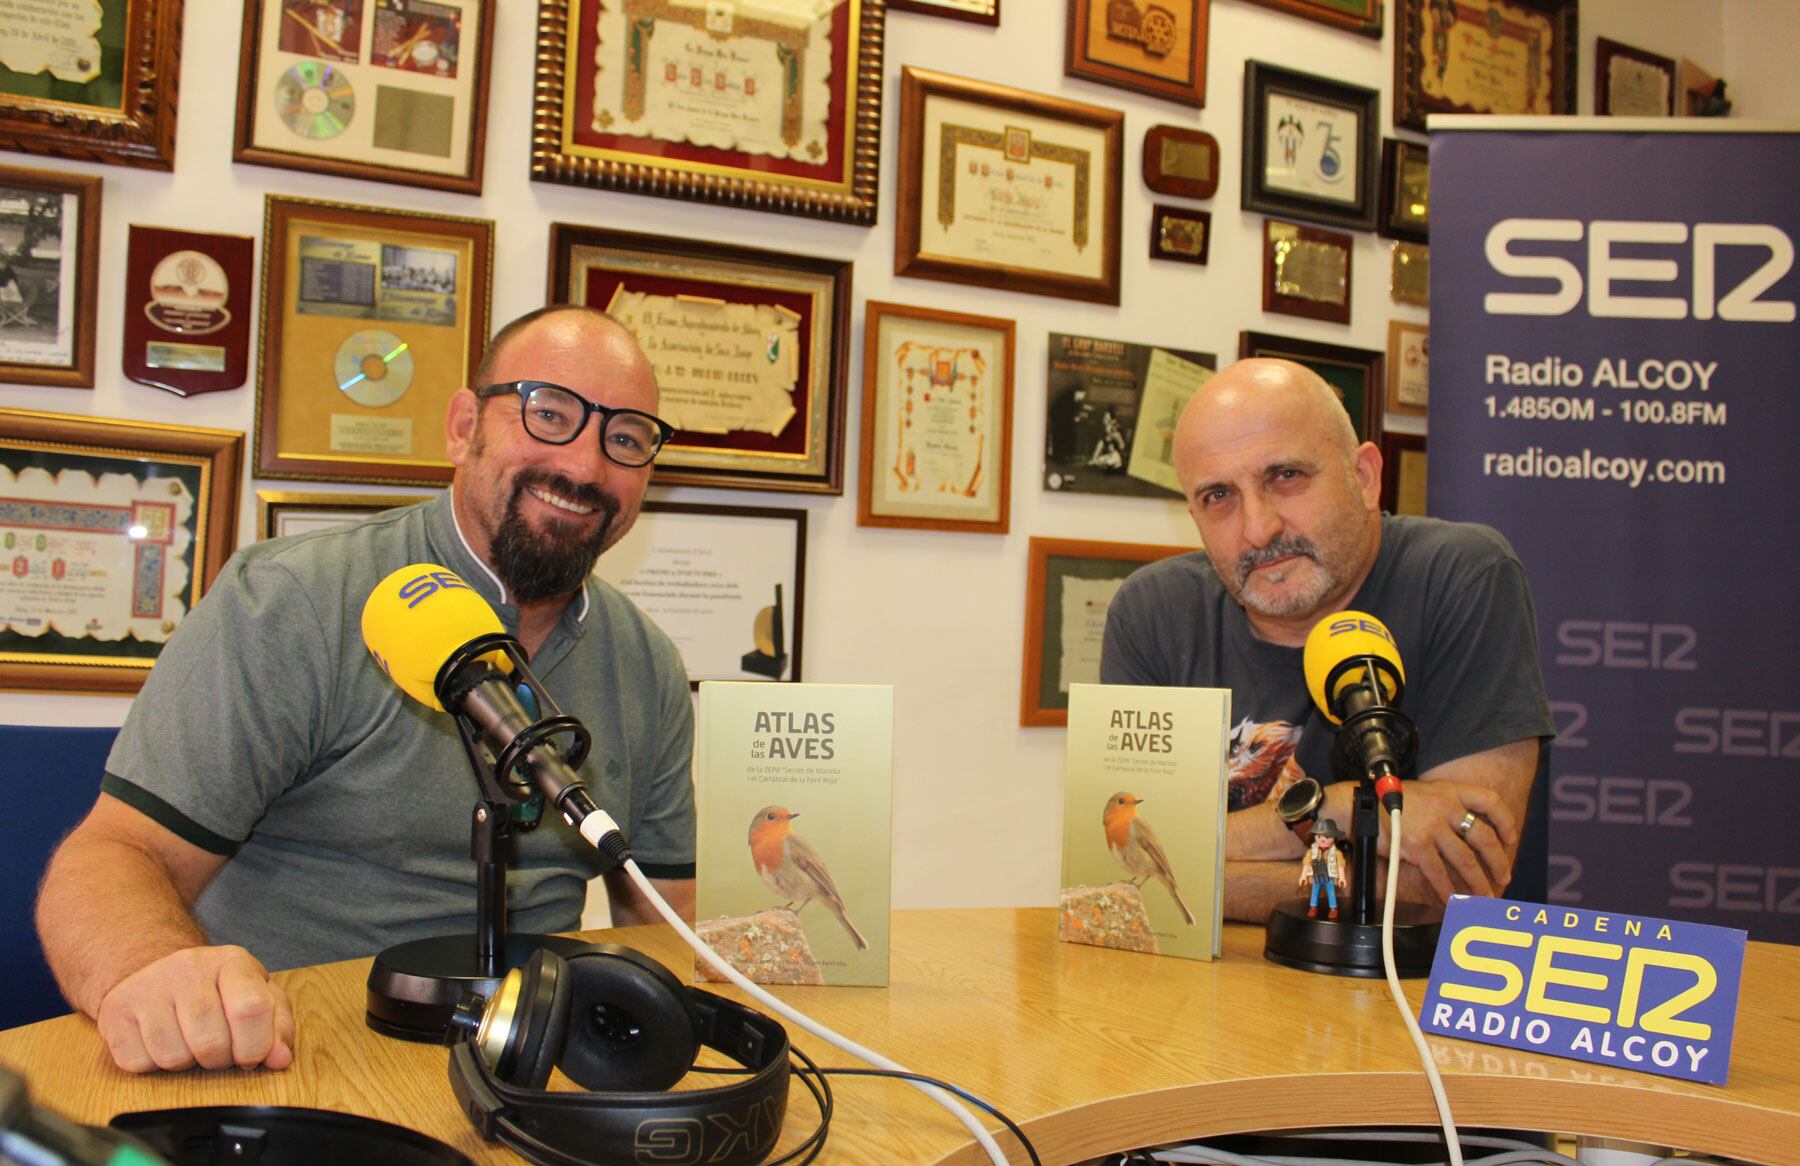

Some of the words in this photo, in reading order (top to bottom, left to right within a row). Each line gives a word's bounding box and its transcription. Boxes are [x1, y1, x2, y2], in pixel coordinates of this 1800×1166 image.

[1484, 218, 1797, 322] SER
[1485, 354, 1584, 387] Radio
[1592, 358, 1718, 391] ALCOY
[1619, 400, 1727, 426] 100.8FM
[1483, 447, 1726, 488] radioalcoy.com
[399, 572, 472, 609] SE
[1556, 620, 1698, 671] SER
[754, 711, 835, 734] ATLAS
[1110, 710, 1173, 731] ATLAS
[753, 739, 765, 748] de
[768, 737, 835, 760] AVES
[1107, 742, 1118, 751] las
[1109, 734, 1118, 742] de
[1121, 732, 1172, 753] AVES
[751, 749, 765, 759] las
[1552, 775, 1693, 827] SER
[1505, 905, 1673, 941] CADENA
[1439, 925, 1718, 1042] SER
[1432, 1003, 1551, 1045] RADIO
[1570, 1026, 1709, 1073] ALCOY
